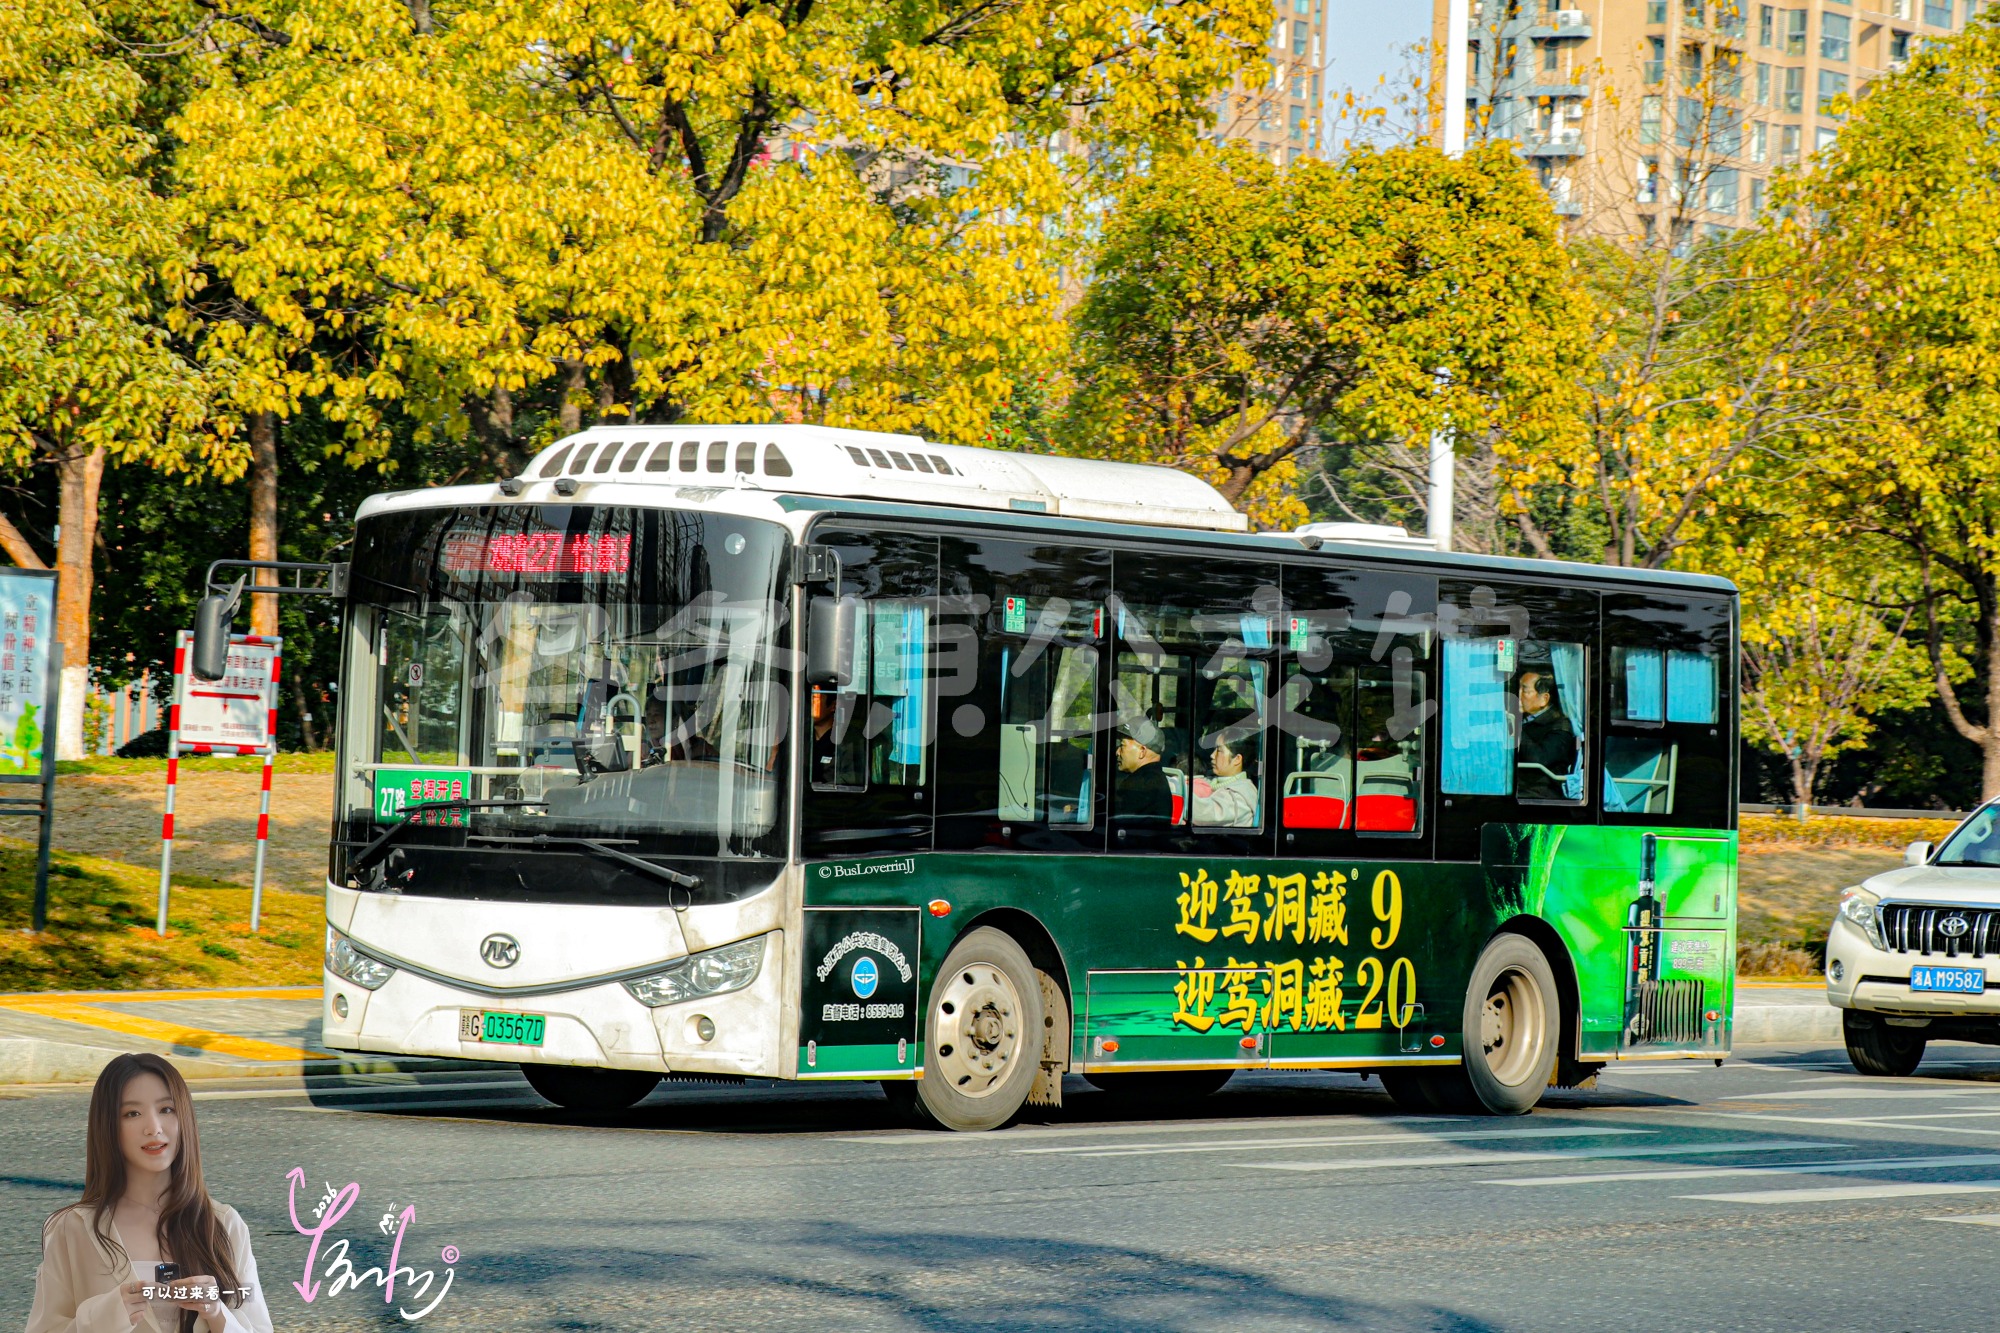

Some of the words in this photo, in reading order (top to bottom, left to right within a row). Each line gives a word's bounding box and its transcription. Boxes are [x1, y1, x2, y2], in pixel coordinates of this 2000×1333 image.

[19, 594, 38, 693] 立精神支柱
[381, 787, 406, 817] 27路
[410, 778, 462, 800] 空调开启
[1175, 868, 1349, 946] 迎驾洞藏
[1371, 869, 1403, 950] 9
[817, 932, 913, 982] 九江市公共交通集团公司
[1172, 956, 1346, 1033] 迎驾洞藏
[1354, 957, 1417, 1029] 20
